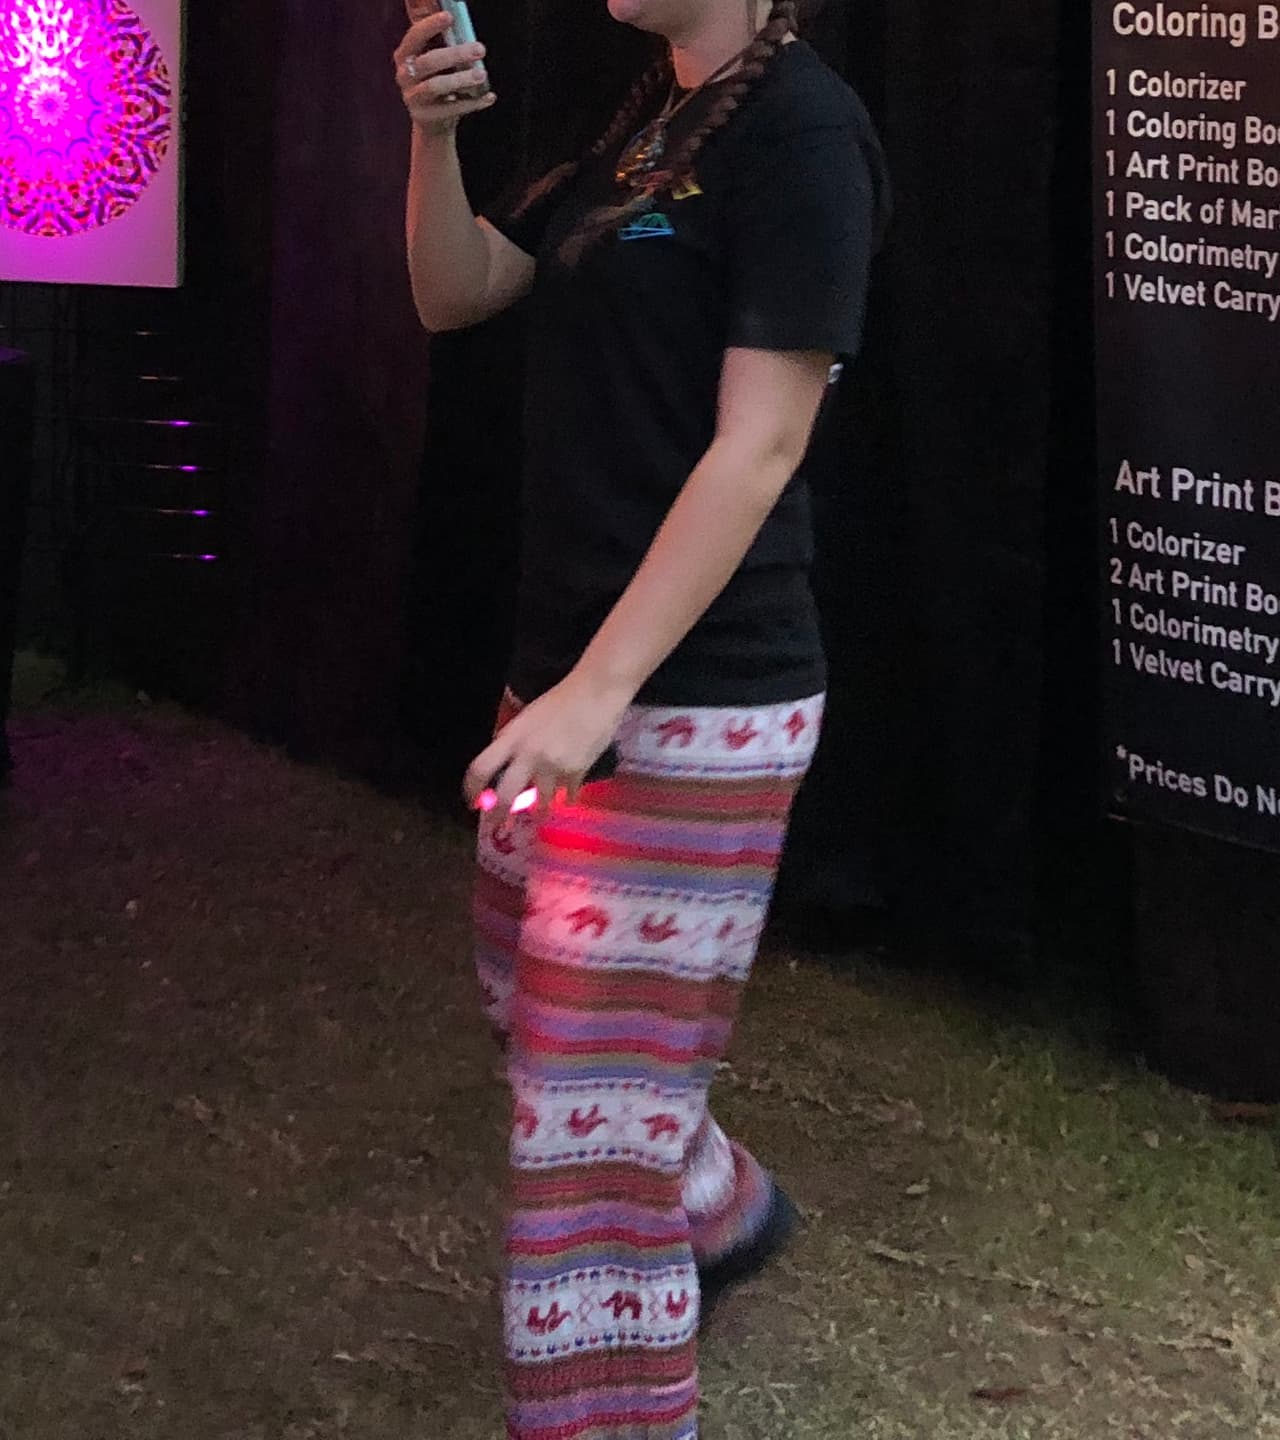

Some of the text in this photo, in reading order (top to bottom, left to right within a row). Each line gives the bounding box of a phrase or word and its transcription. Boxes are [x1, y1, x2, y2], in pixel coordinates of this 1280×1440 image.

[1113, 2, 1247, 47] Coloring
[1105, 69, 1246, 101] 1 Colorizer
[1105, 109, 1116, 135] 1
[1126, 110, 1236, 149] Coloring
[1105, 150, 1116, 175] 1
[1126, 152, 1169, 180] Art
[1178, 154, 1239, 184] Print
[1105, 191, 1116, 216] 1
[1125, 192, 1192, 222] Pack
[1200, 198, 1223, 224] of
[1105, 231, 1115, 257] 1
[1124, 233, 1278, 278] Colorimetry
[1104, 272, 1115, 298] 1
[1124, 273, 1205, 306] Velvet
[1115, 461, 1161, 498] Art
[1172, 467, 1254, 512] Print
[1109, 517, 1246, 566] 1 Colorizer
[1109, 558, 1122, 584] 2
[1128, 562, 1164, 594] Art
[1172, 572, 1237, 607] Print
[1111, 599, 1122, 624] 1
[1130, 602, 1279, 662] Colorimetry
[1112, 639, 1122, 664] 1
[1130, 642, 1203, 685] Velvet
[1214, 774, 1248, 809] Do
